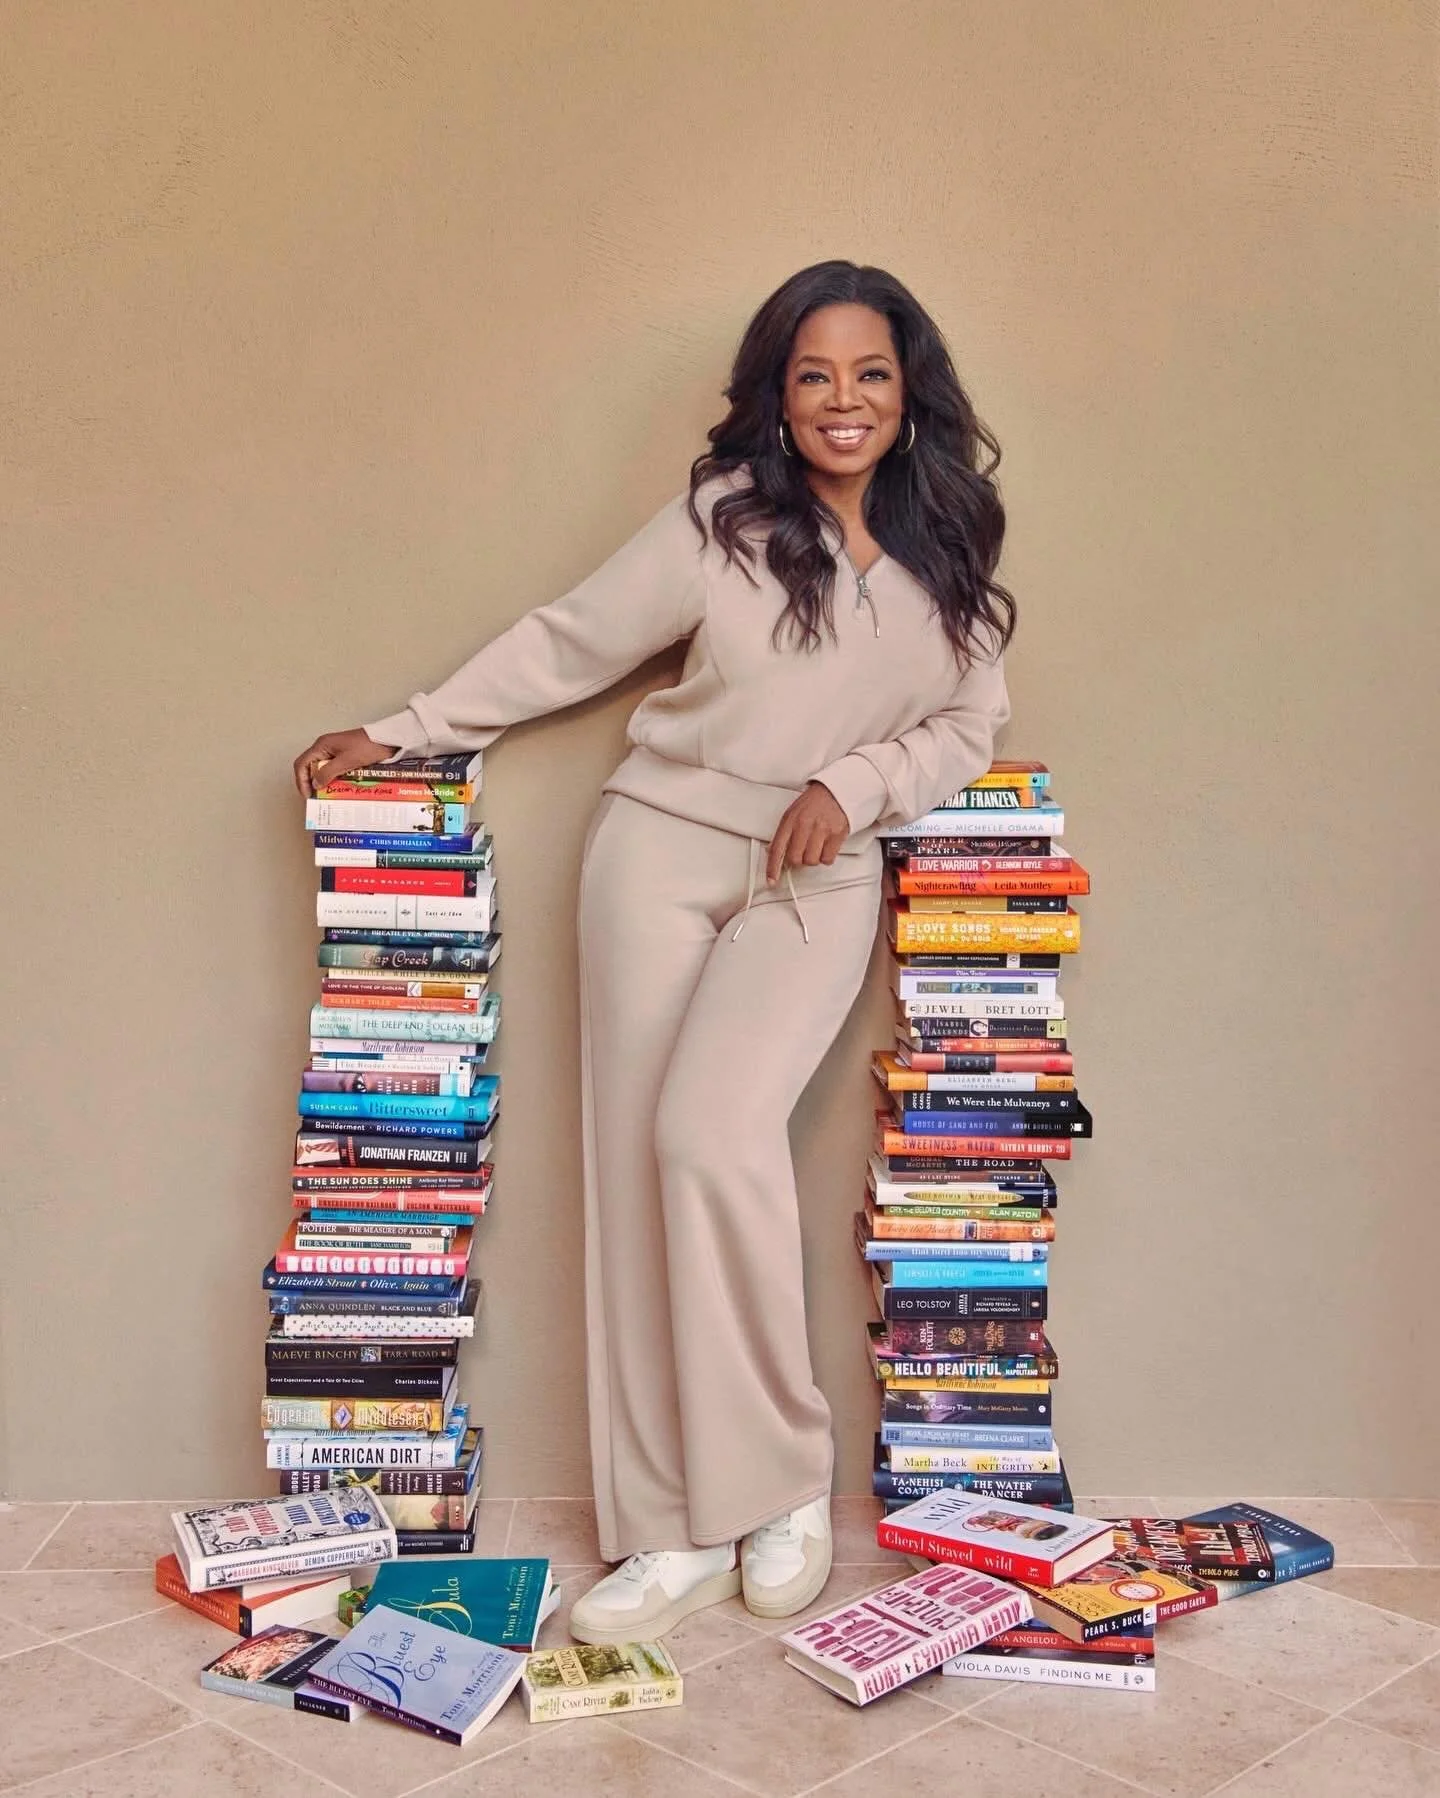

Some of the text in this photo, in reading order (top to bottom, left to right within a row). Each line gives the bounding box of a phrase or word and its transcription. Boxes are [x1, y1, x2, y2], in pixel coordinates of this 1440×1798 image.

[970, 791, 1020, 808] FRANZEN
[888, 824, 1044, 832] BECOMING MICHELLE OBAMA
[319, 836, 364, 844] Midwives
[917, 846, 959, 854] PEARL
[918, 859, 940, 871] LOVE
[942, 860, 979, 871] WARRIOR
[915, 881, 1053, 892] Nightcrawling Leila Mottley
[917, 923, 991, 933] LOVE SONGS
[362, 950, 428, 967] Gap Creek
[924, 1005, 1051, 1015] JEWEL BRET LOTT
[363, 1020, 465, 1032] THE DEEP END OCEAN
[395, 1042, 424, 1053] Robinson
[369, 1101, 448, 1117] Bittersweet
[946, 1097, 1050, 1108] We Were the Mulvaneys
[315, 1121, 457, 1134] Bewilderment RICHARD POWERS
[912, 1121, 935, 1129] HOUSE
[936, 1121, 945, 1129] OF
[902, 1140, 958, 1151] SWEETNESS
[360, 1147, 406, 1160] JONATHAN
[408, 1149, 450, 1162] FRANZEN
[330, 1177, 350, 1185] SUN
[352, 1177, 379, 1185] DOES
[383, 1177, 412, 1185] SHINE
[915, 1206, 970, 1217] BELOVED COUNTRY
[302, 1224, 337, 1233] POITIER
[362, 1226, 395, 1234] MEASURE
[278, 1277, 430, 1290] Elizabeth Strout Olive, Again
[926, 1321, 934, 1351] FOLLETT
[987, 1321, 995, 1351] PILLARS
[997, 1324, 1005, 1347] EARTH
[272, 1351, 311, 1359] MAEVE
[315, 1351, 358, 1359] BINCHY
[895, 1363, 1001, 1376] HELLO BEAUTIFUL
[966, 1380, 997, 1390] Robinson
[312, 1447, 421, 1464] AMERICAN DIRT
[904, 1457, 967, 1467] Martha Beck
[977, 1463, 1034, 1471] INTEGRITY
[898, 1487, 937, 1495] COATES
[973, 1480, 1032, 1490] THE WATER
[982, 1490, 1023, 1499] DANCER
[1142, 1519, 1187, 1561] DREAMERS
[886, 1530, 1013, 1571] Cheryl Strayed wild
[233, 1550, 365, 1578] BARBARA KINGSOLVER DEMON COPPERHEAD
[1199, 1568, 1222, 1576] IMBOLO
[904, 1566, 1017, 1616] BOND
[388, 1576, 472, 1636] Sula
[502, 1565, 529, 1639] Toni Morrison
[872, 1586, 967, 1631] CYNTHIA
[1160, 1596, 1206, 1616] THE GOOD EARTH
[1085, 1615, 1142, 1638] PEARL S. BUCK
[792, 1609, 922, 1672] RUBY
[1013, 1635, 1057, 1645] ANGELOU
[864, 1662, 901, 1700] RUBY
[912, 1625, 980, 1674] CYNTHIA
[982, 1600, 1022, 1637] BOND
[403, 1645, 446, 1681] Eye
[955, 1662, 1031, 1675] VIOLA DAVIS
[1040, 1668, 1112, 1681] FINDING ME
[313, 1678, 373, 1707] THE BLUEST EYE
[440, 1654, 505, 1721] Toni Morrison
